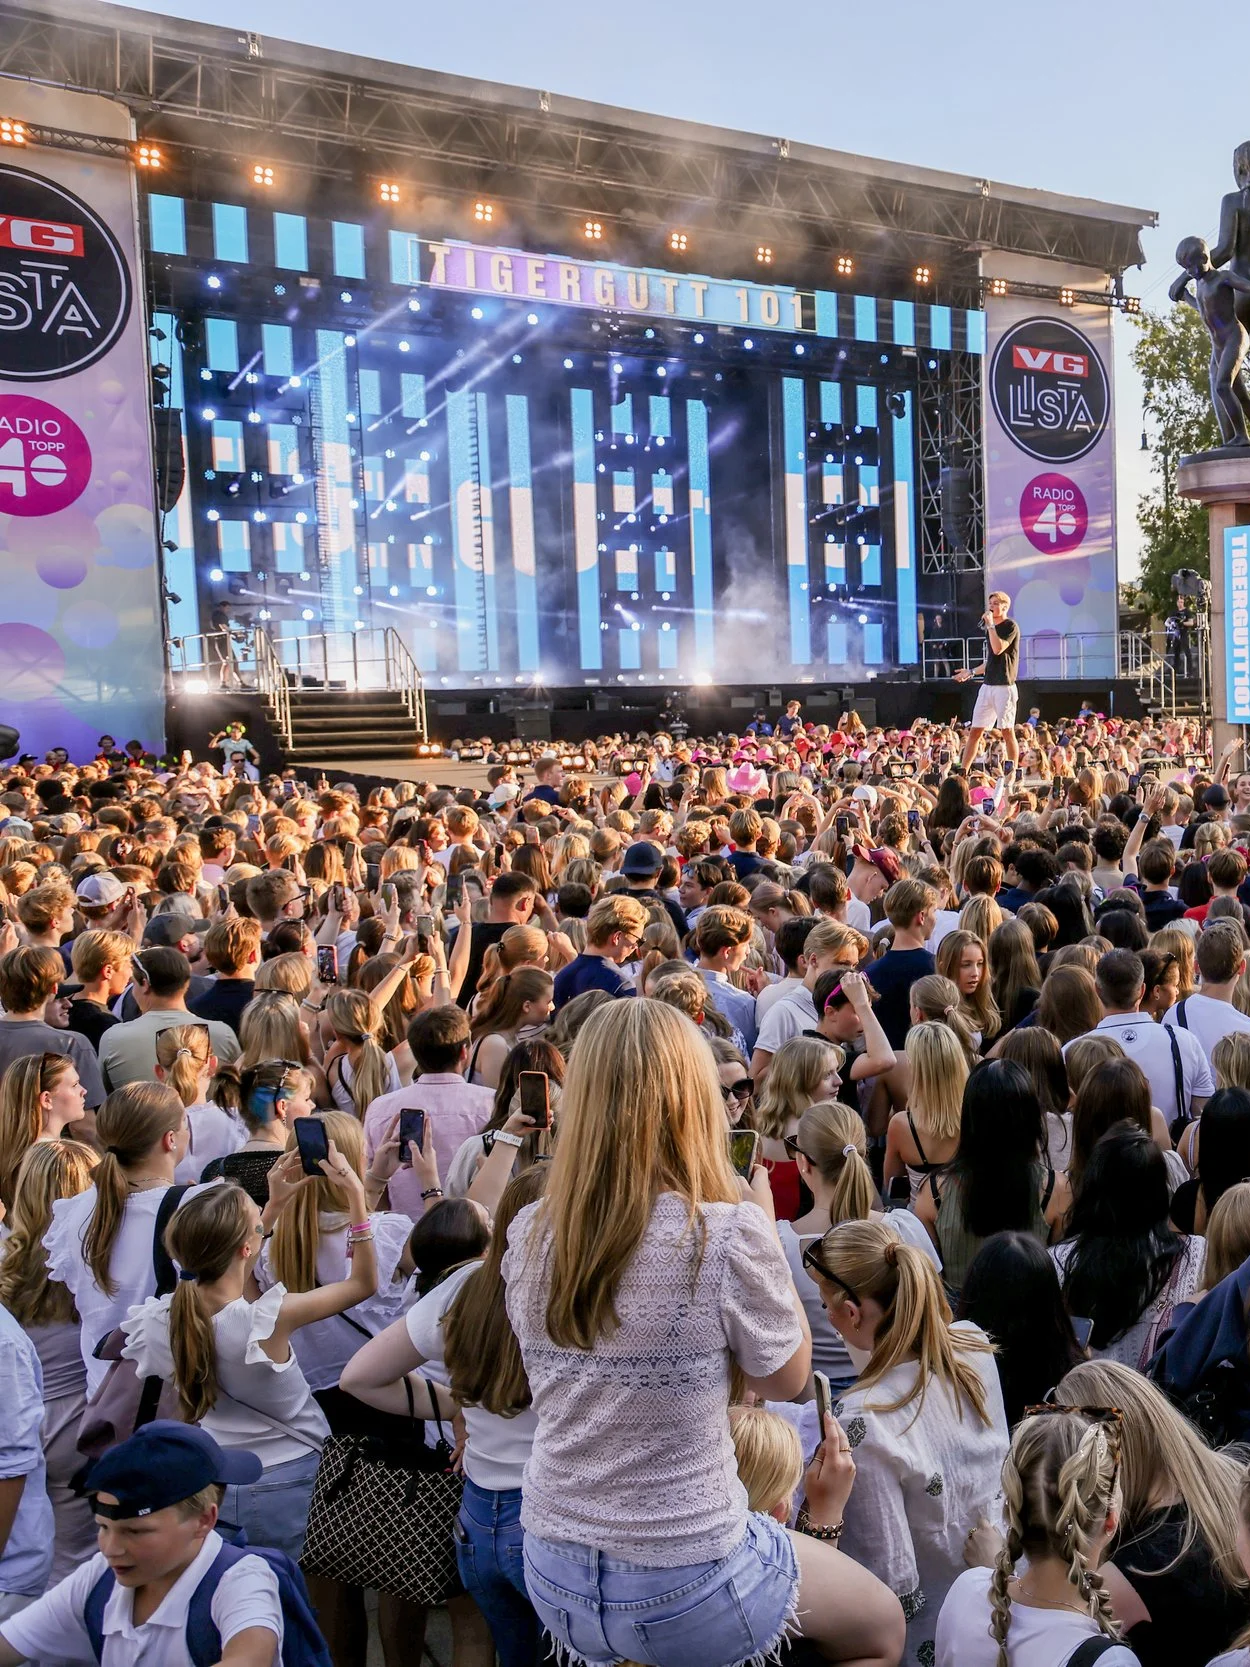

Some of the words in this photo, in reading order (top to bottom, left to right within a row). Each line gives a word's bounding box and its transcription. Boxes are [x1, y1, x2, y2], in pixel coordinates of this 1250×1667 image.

[0, 217, 75, 253] G
[428, 244, 708, 318] TIGERGUTT
[735, 288, 803, 328] 101
[1016, 347, 1084, 375] VG
[28, 440, 65, 452] TOPP
[1033, 487, 1074, 502] RADIO
[1057, 503, 1076, 511] TOPP
